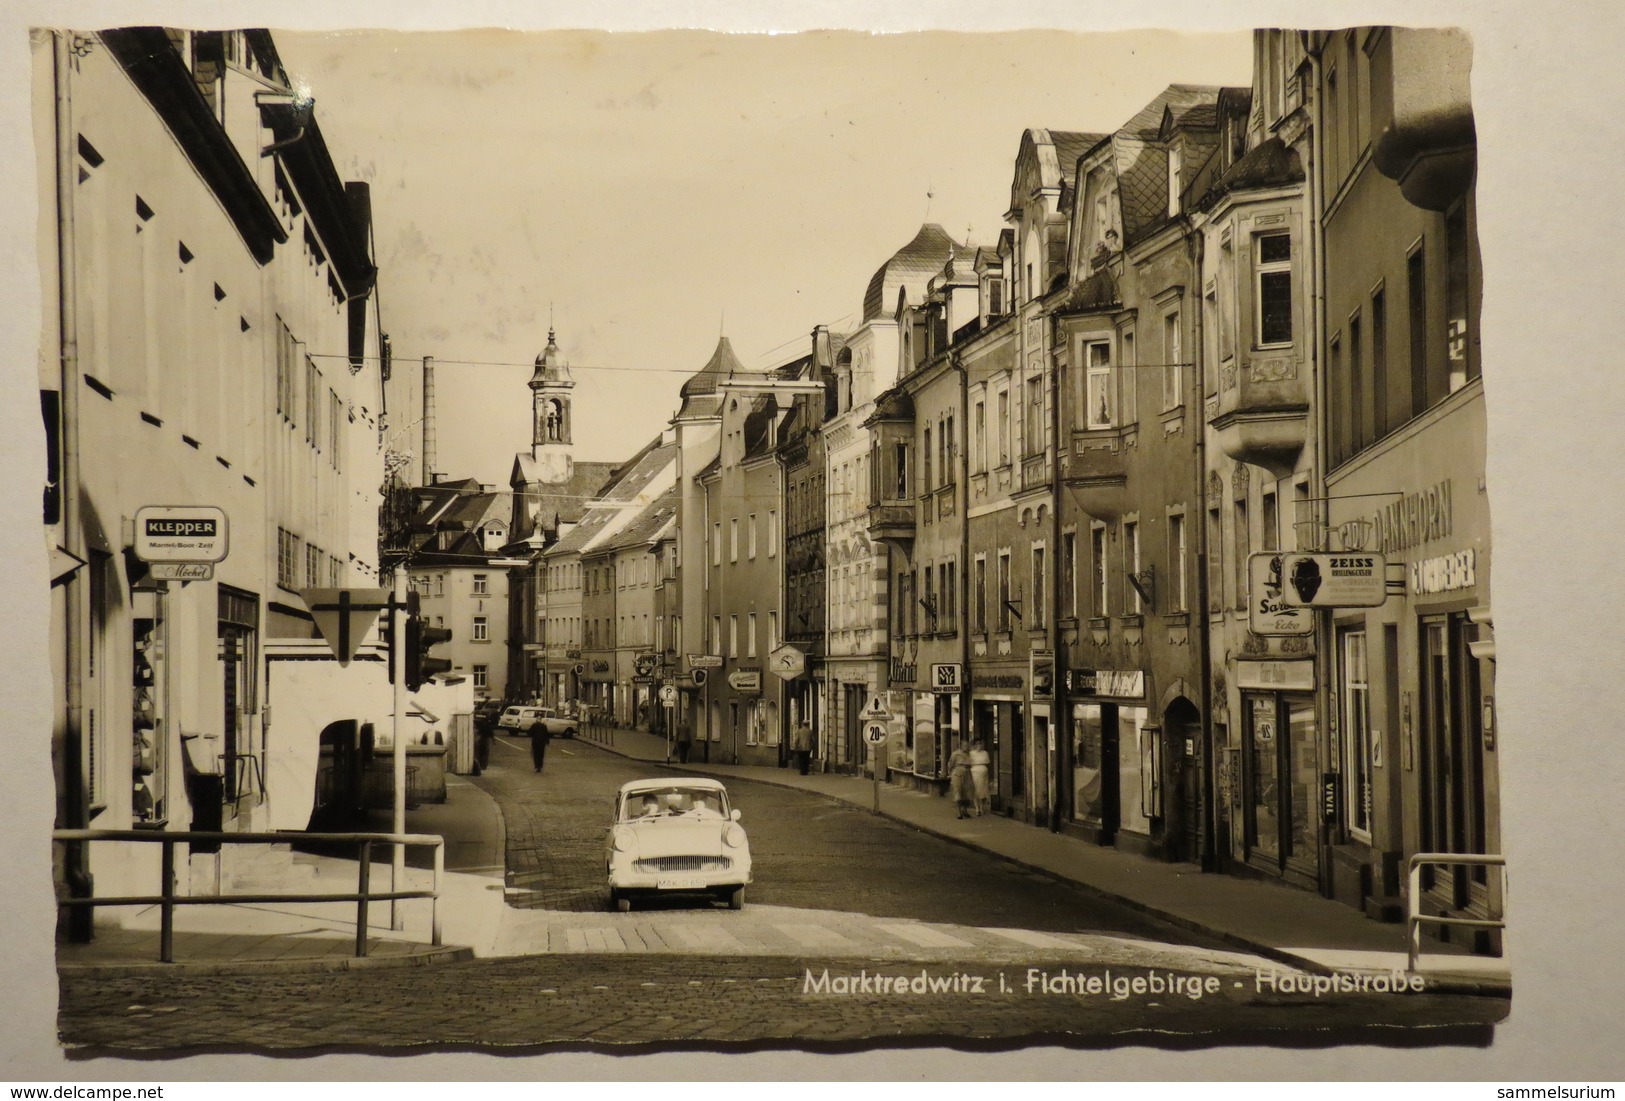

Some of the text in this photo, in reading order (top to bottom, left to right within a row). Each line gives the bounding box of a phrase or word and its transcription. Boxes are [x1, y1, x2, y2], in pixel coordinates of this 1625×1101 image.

[1374, 479, 1452, 555] DANNHORN
[149, 523, 213, 535] KLEPPER
[1330, 558, 1373, 568] ZEISS
[939, 666, 954, 685] WMF
[665, 687, 672, 698] P
[870, 726, 880, 741] 20
[1325, 783, 1334, 815] VIVIL
